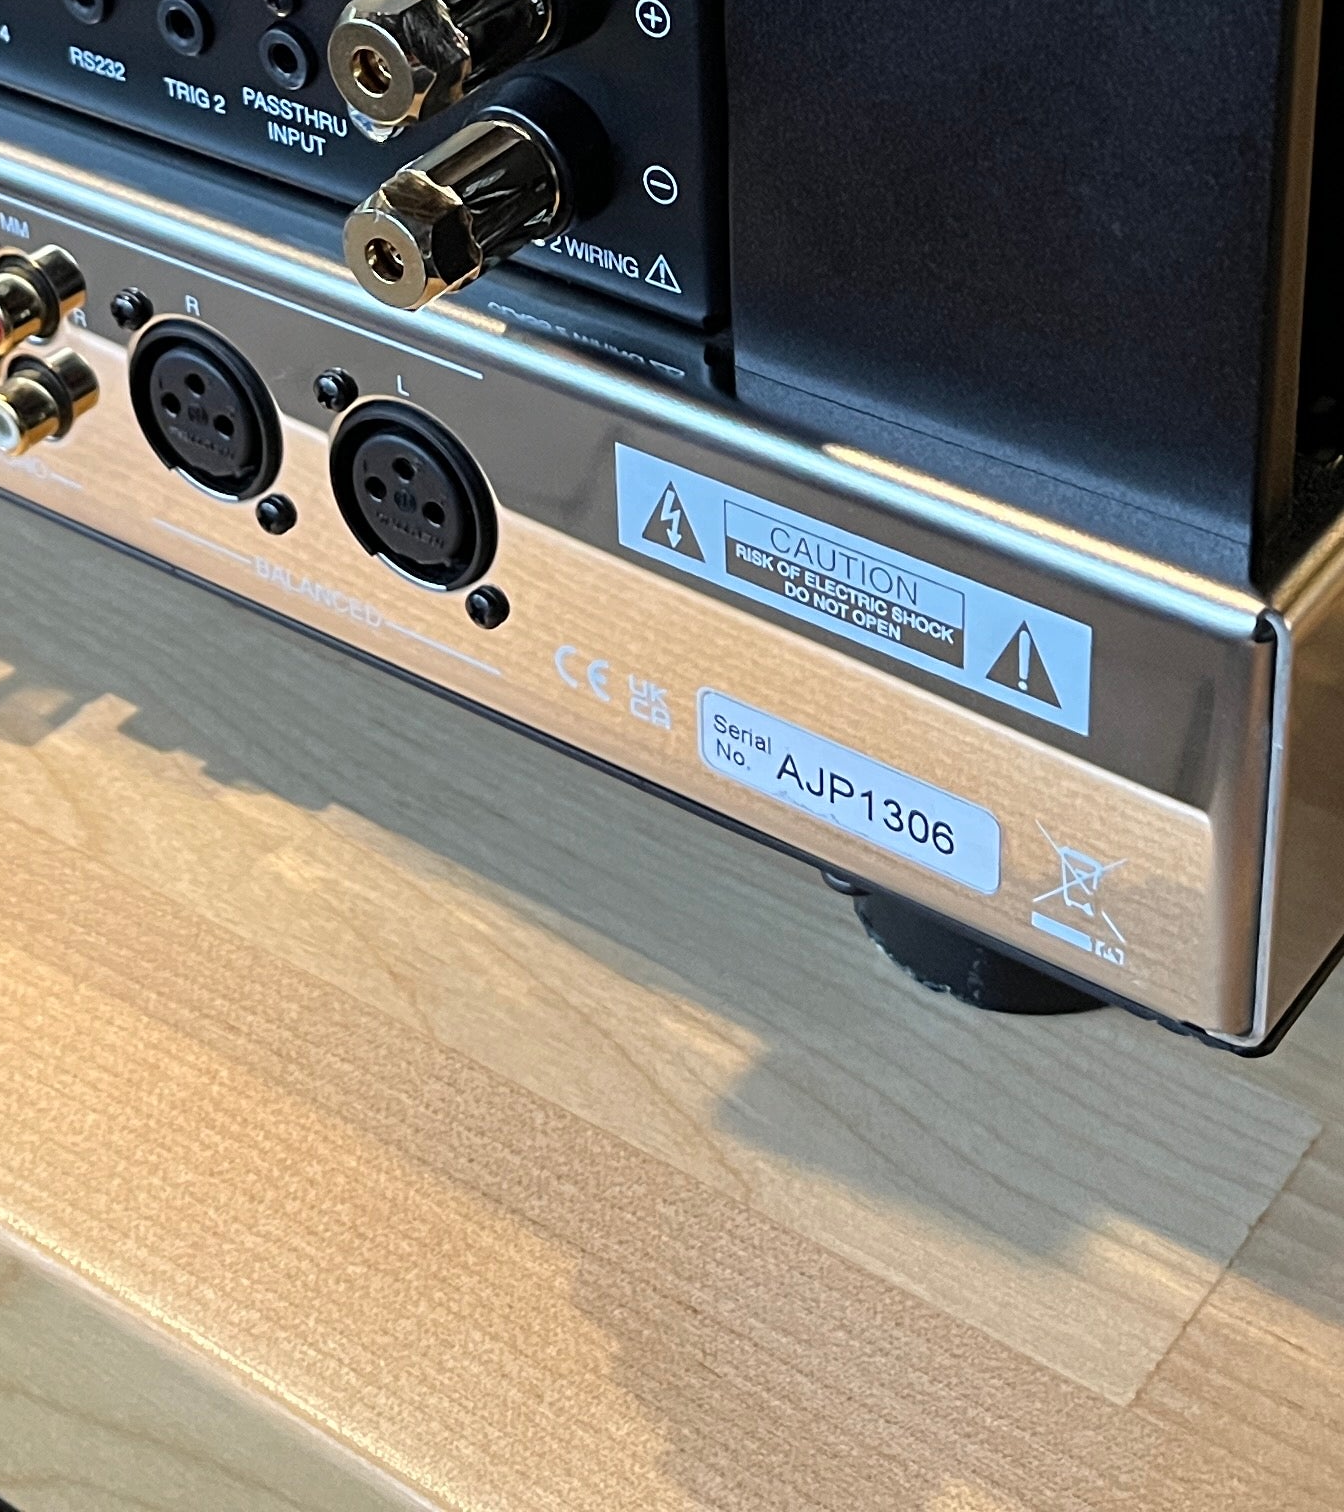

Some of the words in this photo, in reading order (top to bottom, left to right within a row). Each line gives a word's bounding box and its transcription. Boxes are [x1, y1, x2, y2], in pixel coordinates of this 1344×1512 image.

[69, 45, 127, 82] RS232
[163, 76, 211, 110] TRIG
[213, 94, 227, 115] 2
[242, 86, 348, 138] PASSTHRU
[268, 121, 327, 156] INPUT
[0, 211, 30, 239] MM
[564, 235, 640, 279] WIRING
[71, 307, 88, 328] R
[185, 294, 201, 317] R
[397, 374, 410, 397] L
[770, 527, 918, 607] CAUTION
[255, 556, 382, 628] BALANCED
[735, 543, 774, 572] RISK
[776, 560, 801, 580] OF
[804, 571, 888, 617] ELECTRIC
[891, 606, 955, 645] SHOCK
[784, 580, 811, 603] DO
[813, 593, 849, 619] NOT
[852, 609, 902, 641] OPEN
[713, 714, 772, 755] Serial
[716, 738, 751, 771] No.
[776, 753, 955, 856] AJP1306
